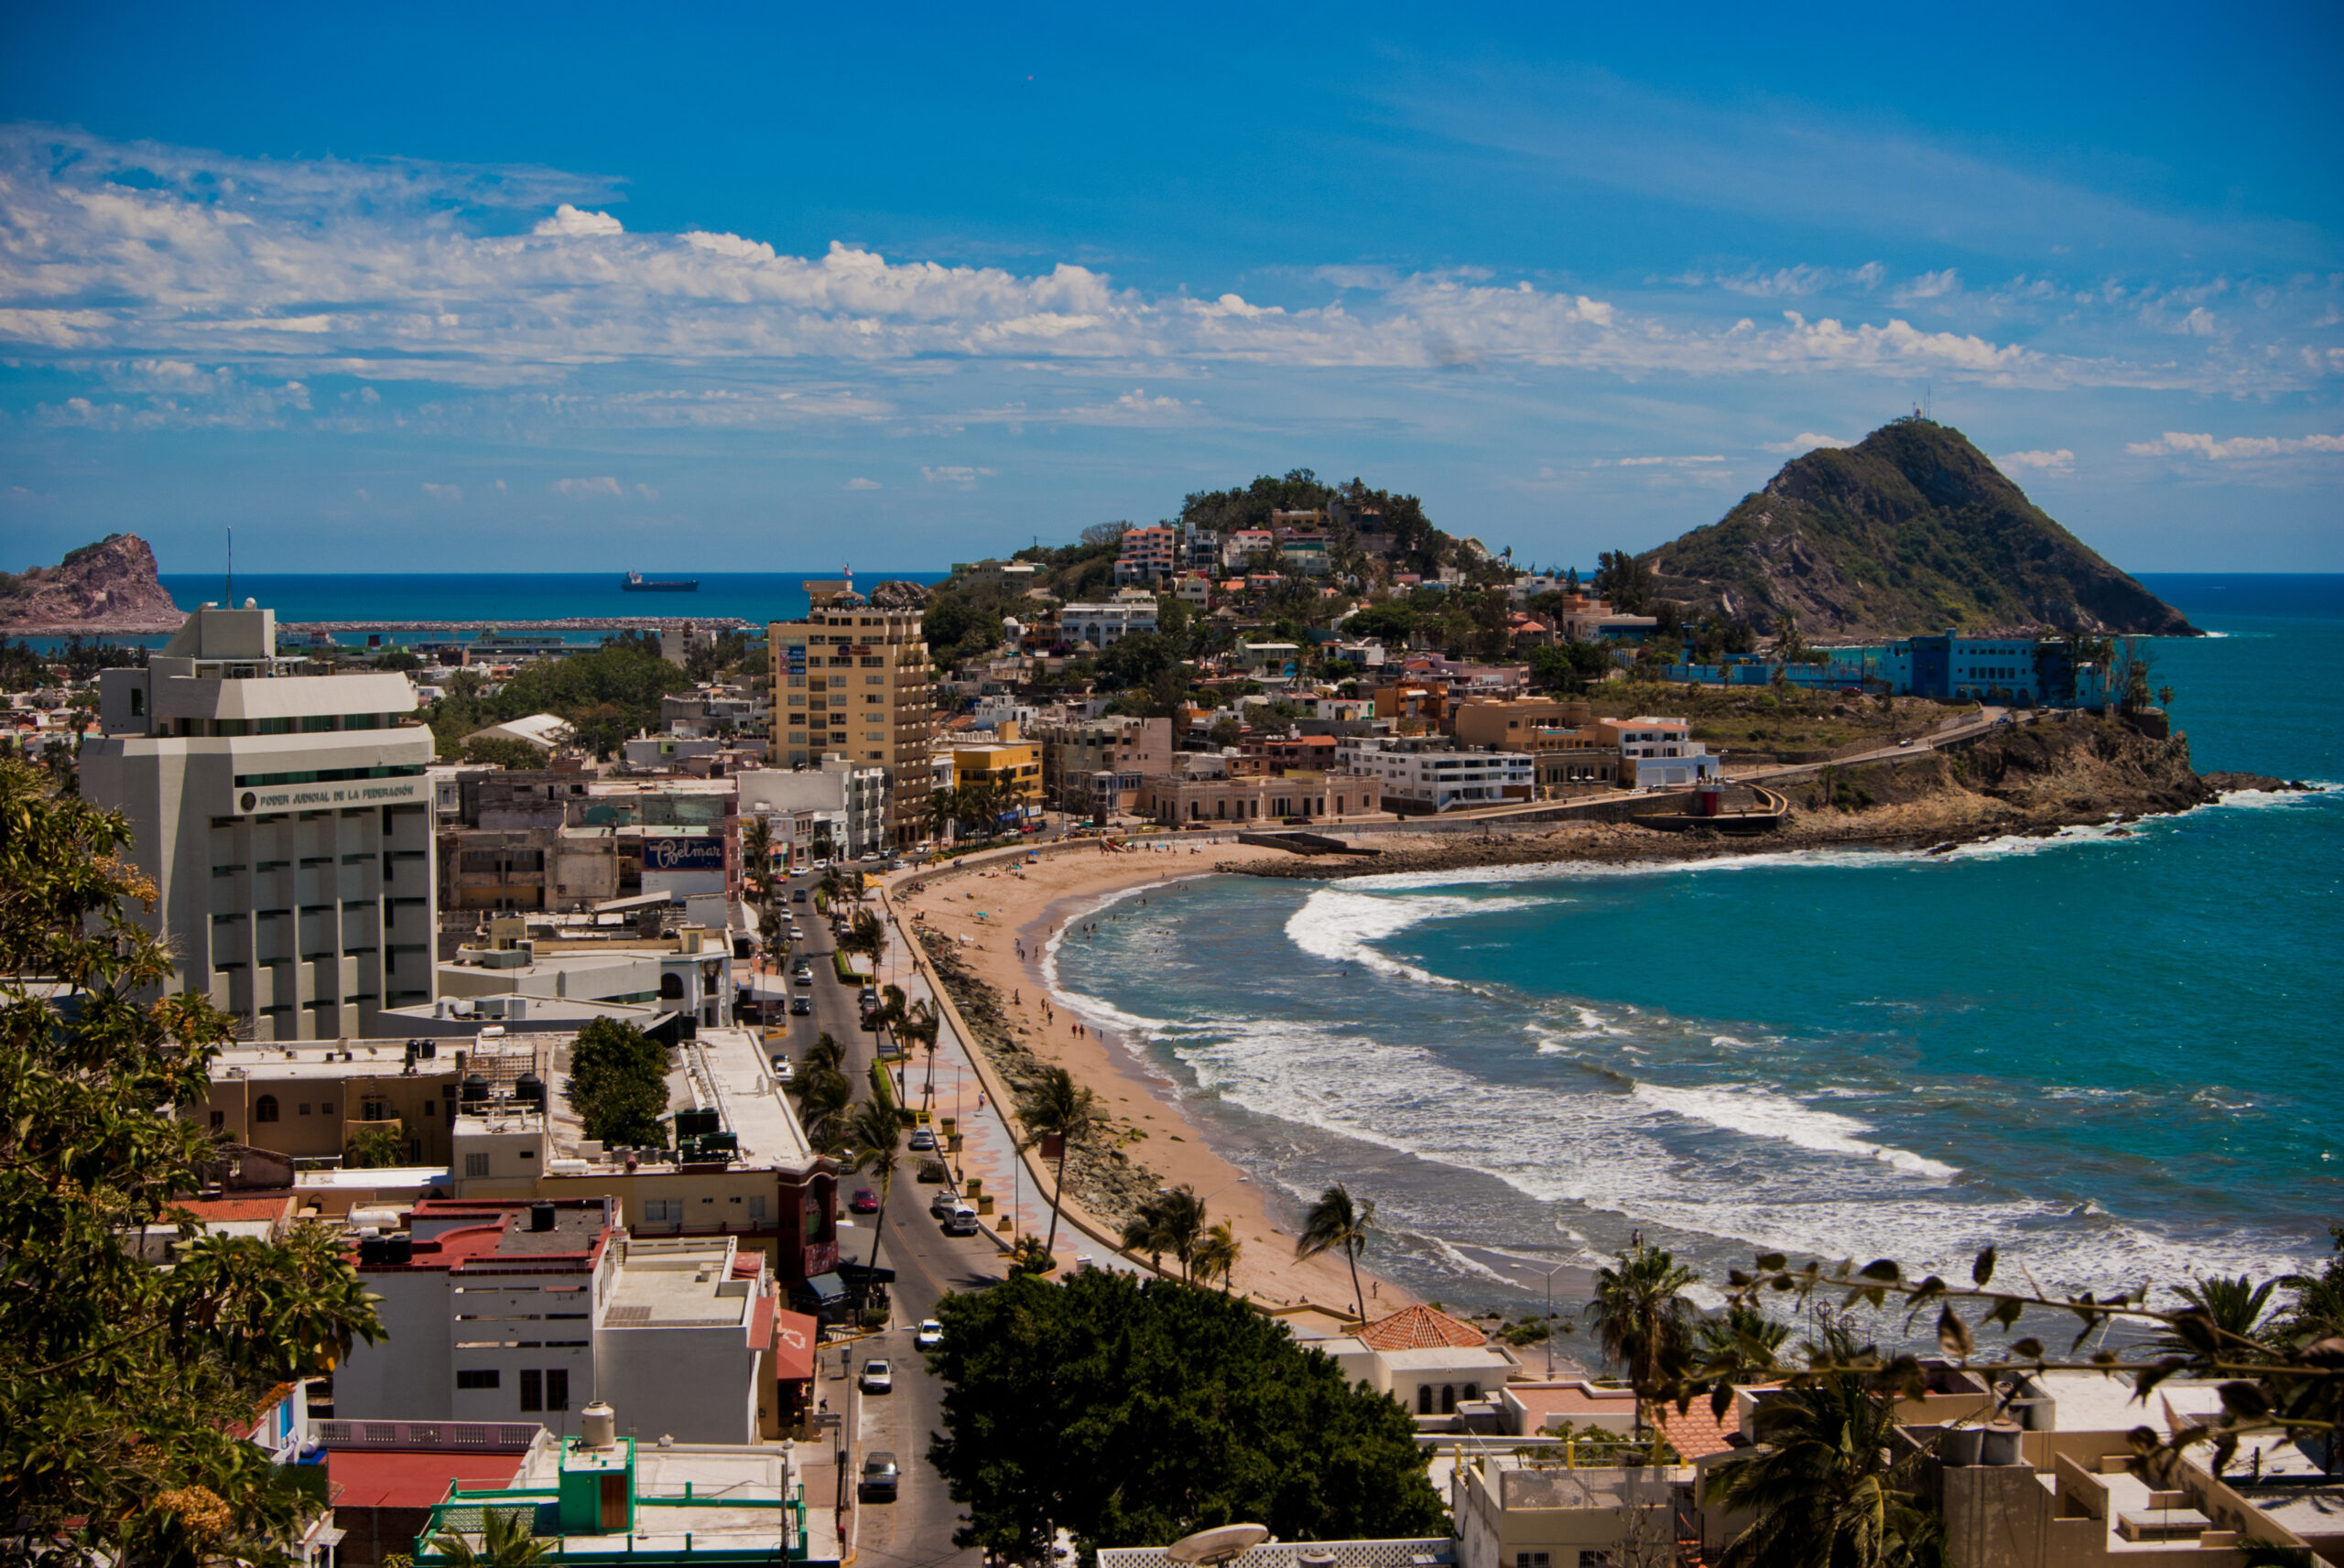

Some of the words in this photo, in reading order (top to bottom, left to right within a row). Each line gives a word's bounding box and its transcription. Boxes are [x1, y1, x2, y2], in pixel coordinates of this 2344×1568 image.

[261, 795, 289, 806] PODER
[292, 791, 330, 805] JUDICIAL
[333, 790, 345, 801] DE
[348, 789, 360, 800] LA
[364, 784, 414, 799] FEDERACIÓN
[657, 839, 722, 868] Belmar
